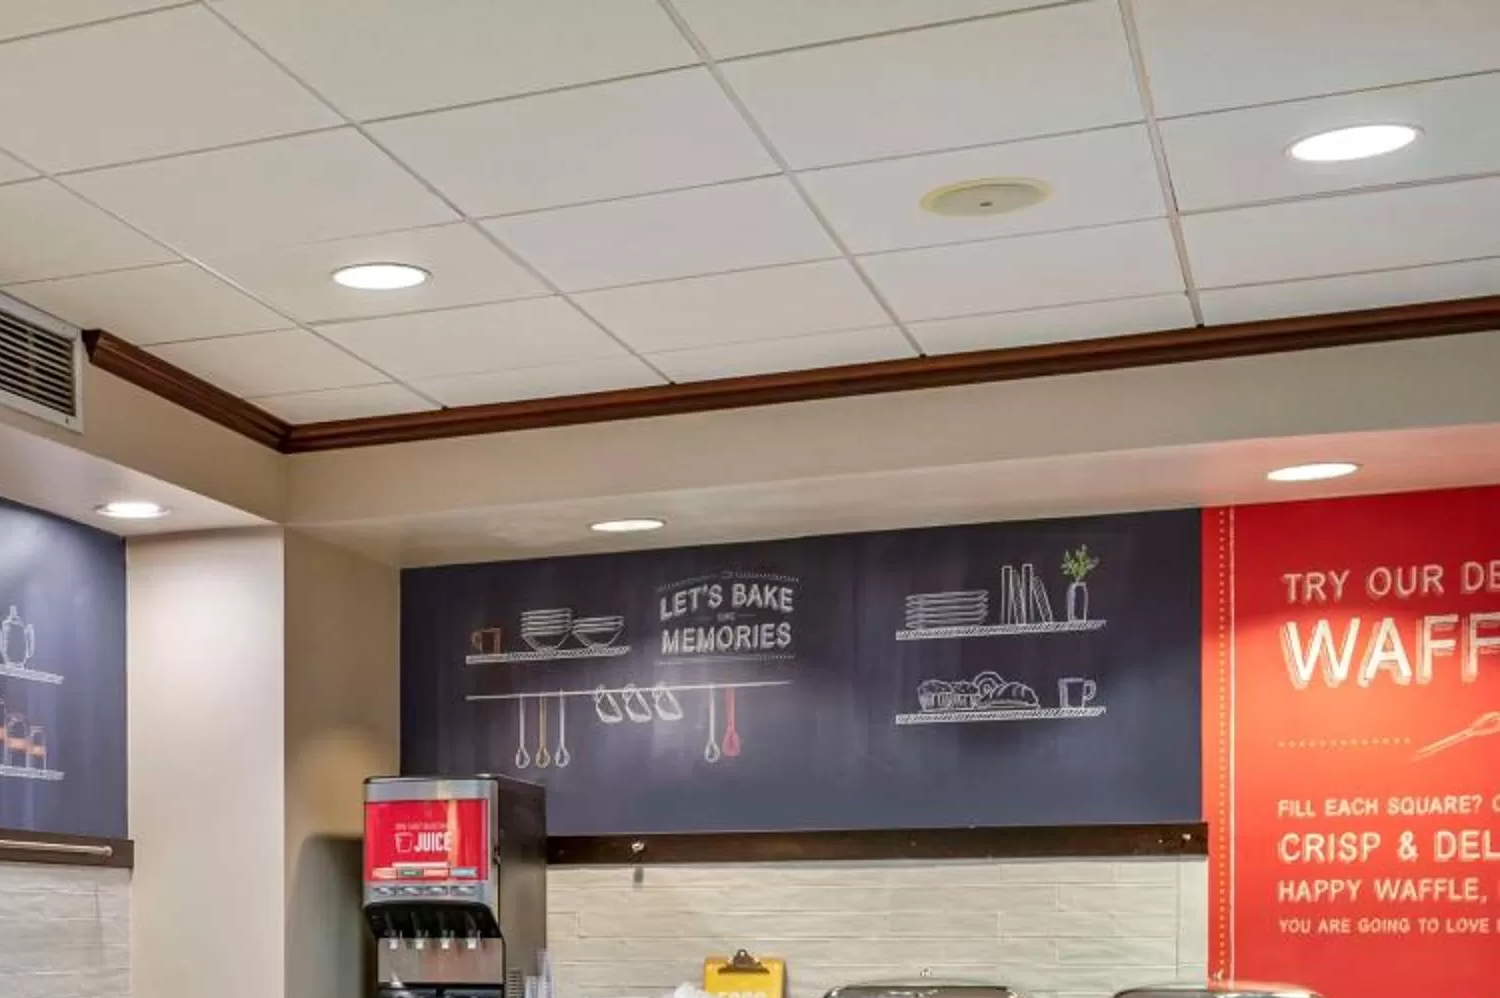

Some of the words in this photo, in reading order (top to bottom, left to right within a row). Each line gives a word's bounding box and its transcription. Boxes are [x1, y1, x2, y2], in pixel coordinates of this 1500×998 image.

[1283, 570, 1350, 604] TRY
[1366, 563, 1445, 599] OUR
[660, 583, 723, 621] LET'S
[732, 583, 794, 613] BAKE
[661, 621, 792, 656] MEMORIES
[1280, 612, 1500, 688] WAFF
[1277, 799, 1316, 818] FILL
[1325, 798, 1379, 817] EACH
[1387, 794, 1483, 816] SQUARE?
[414, 831, 453, 853] JUICE
[1278, 831, 1381, 863] CRISP
[1397, 828, 1419, 862] &
[1433, 828, 1500, 862] DEL
[1278, 879, 1363, 903] HAPPY
[1279, 918, 1312, 934] YOU
[1318, 918, 1351, 933] ARE
[1357, 917, 1411, 933] GOING
[1418, 917, 1439, 933] TO
[1446, 917, 1490, 933] LOVE
